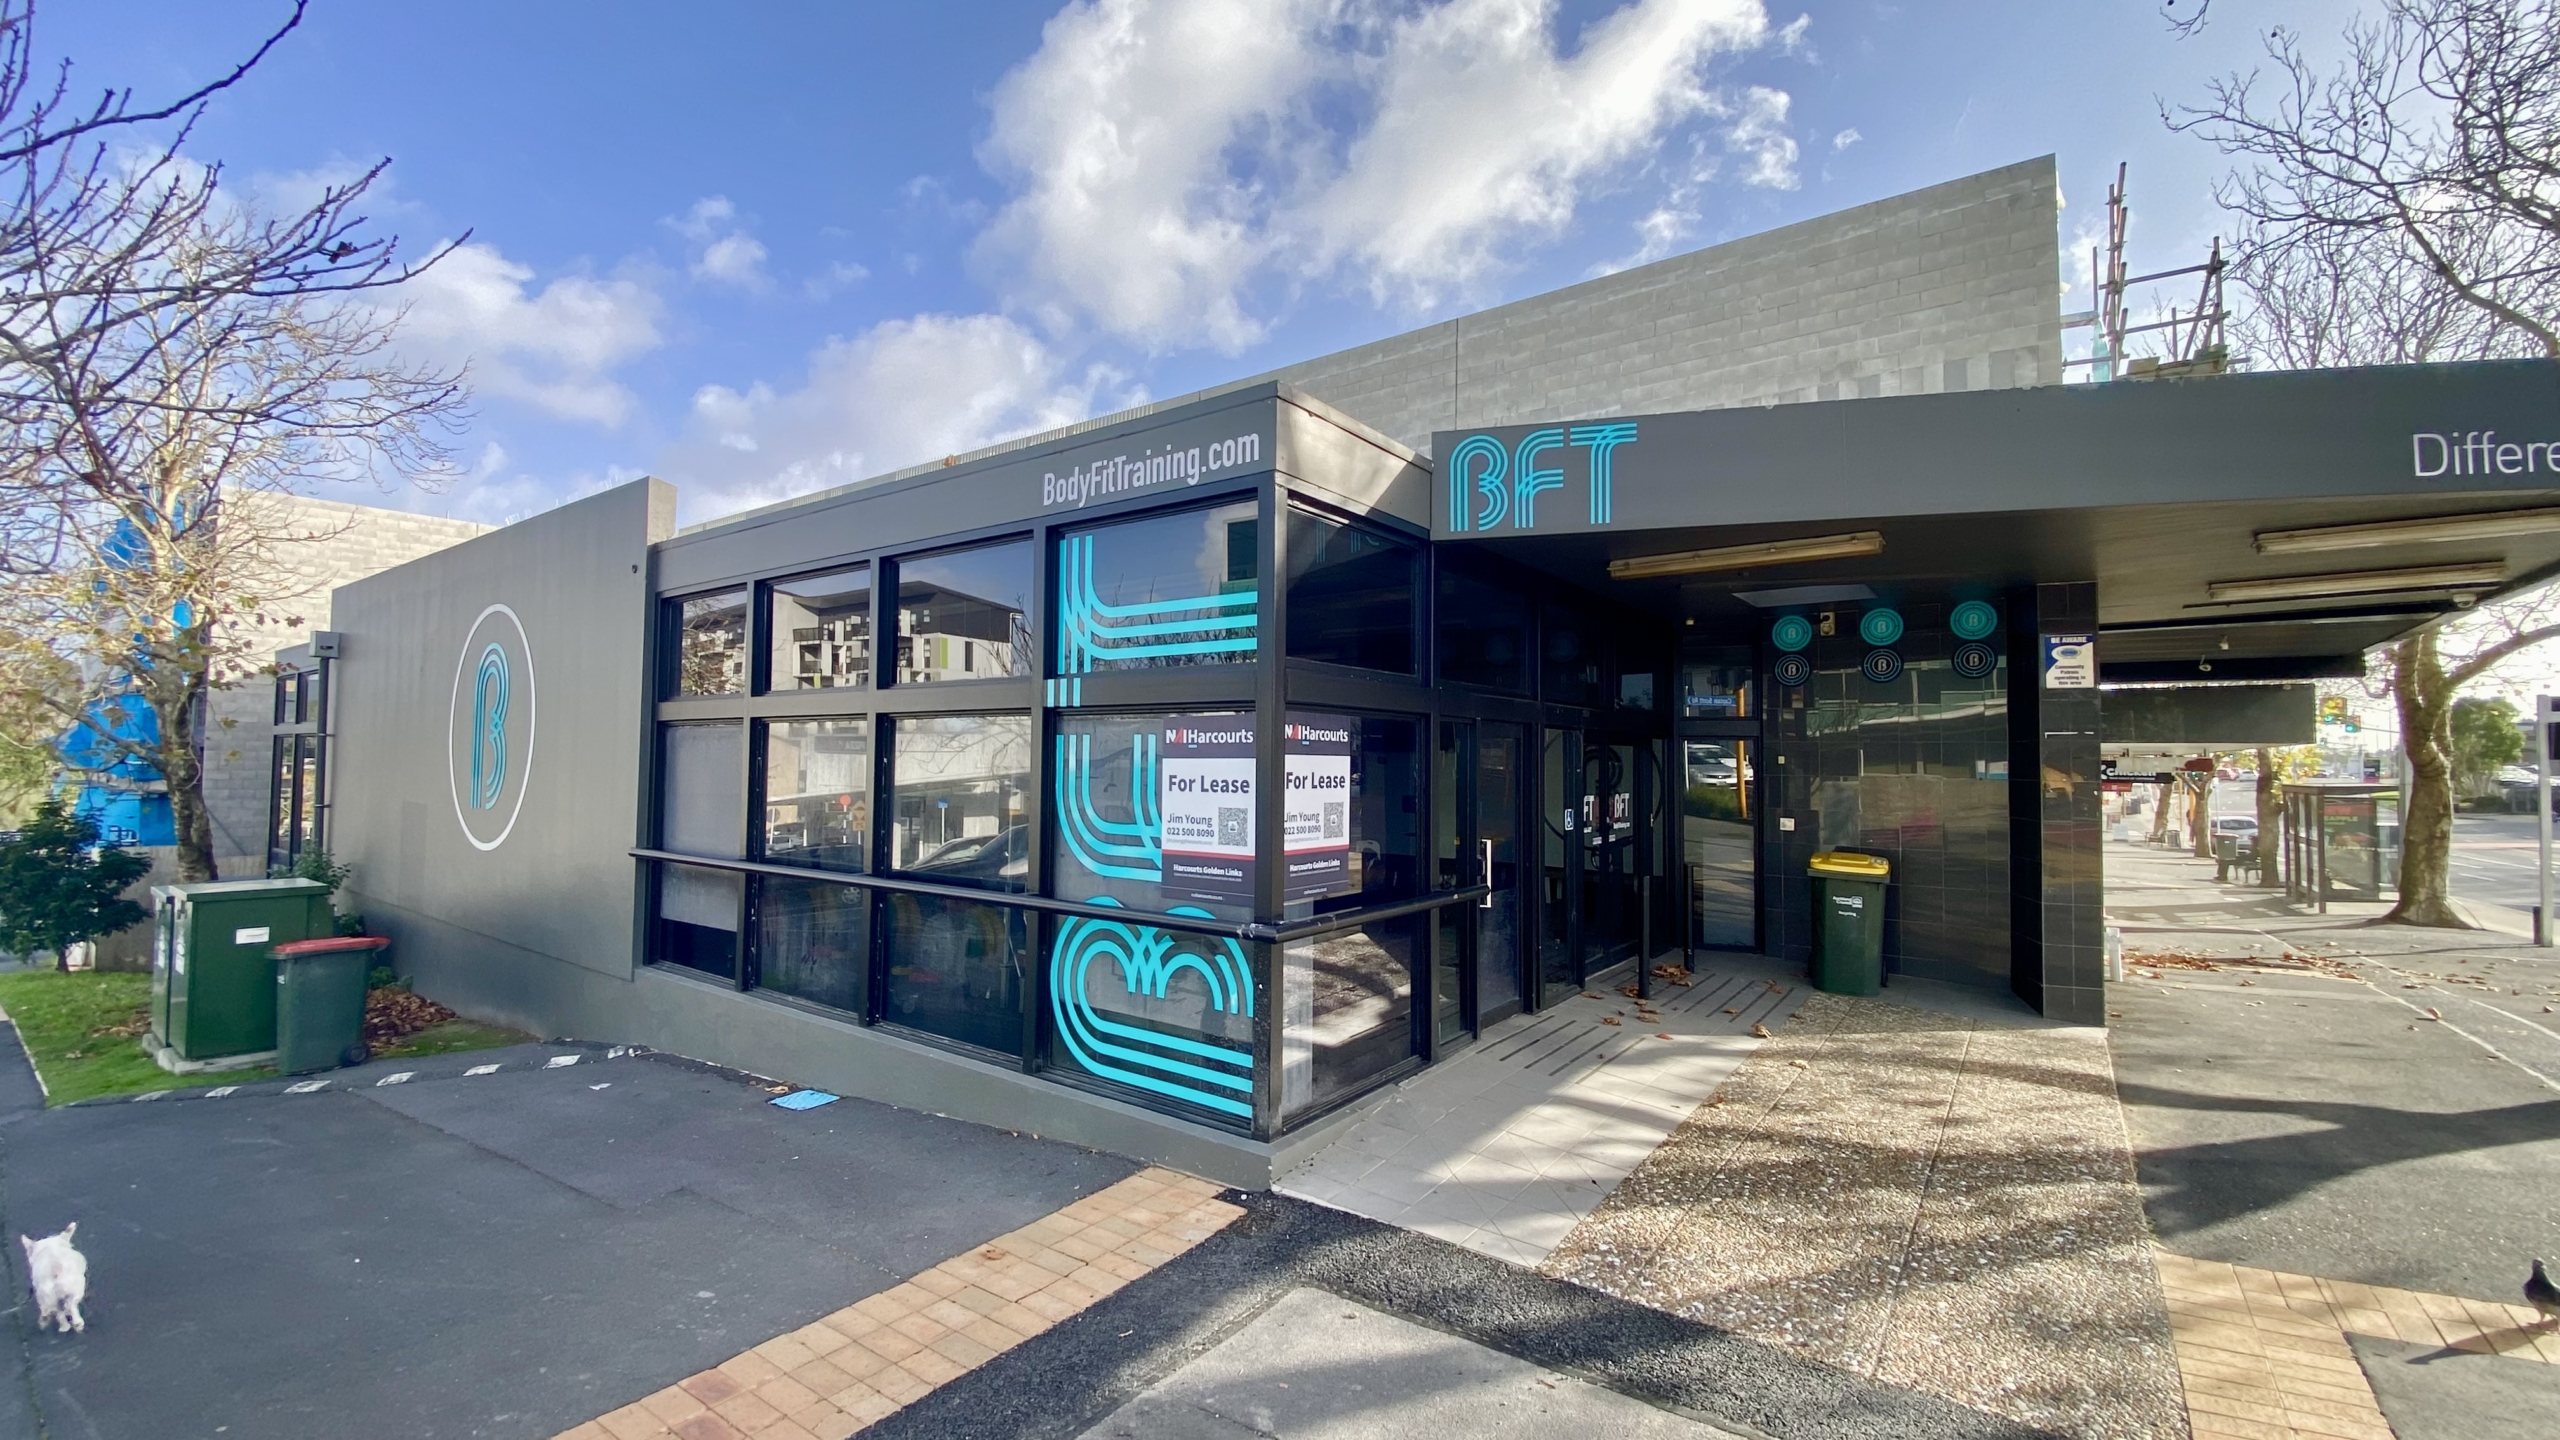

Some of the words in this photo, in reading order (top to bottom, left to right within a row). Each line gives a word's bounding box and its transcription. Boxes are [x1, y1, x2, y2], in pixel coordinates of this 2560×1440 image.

[1043, 433, 1259, 508] BodyFitTraining.com
[1450, 423, 1637, 532] BFT
[1169, 774, 1196, 792] For
[1201, 775, 1250, 794] Lease
[1286, 772, 1308, 789] For
[1312, 772, 1346, 789] Lease
[1614, 793, 1630, 818] BFT
[1167, 813, 1183, 824] Jim
[1185, 814, 1213, 828] Young
[1284, 812, 1297, 823] Jim
[1299, 812, 1320, 824] Young
[1167, 827, 1180, 836] 022
[1182, 828, 1195, 837] 500
[1196, 829, 1215, 838] 8090
[1284, 826, 1295, 835] 022
[1296, 826, 1306, 835] 500
[1308, 825, 1321, 834] 8090
[1173, 864, 1202, 873] Harcourts
[1203, 866, 1224, 875] Golden
[1225, 867, 1243, 877] Links
